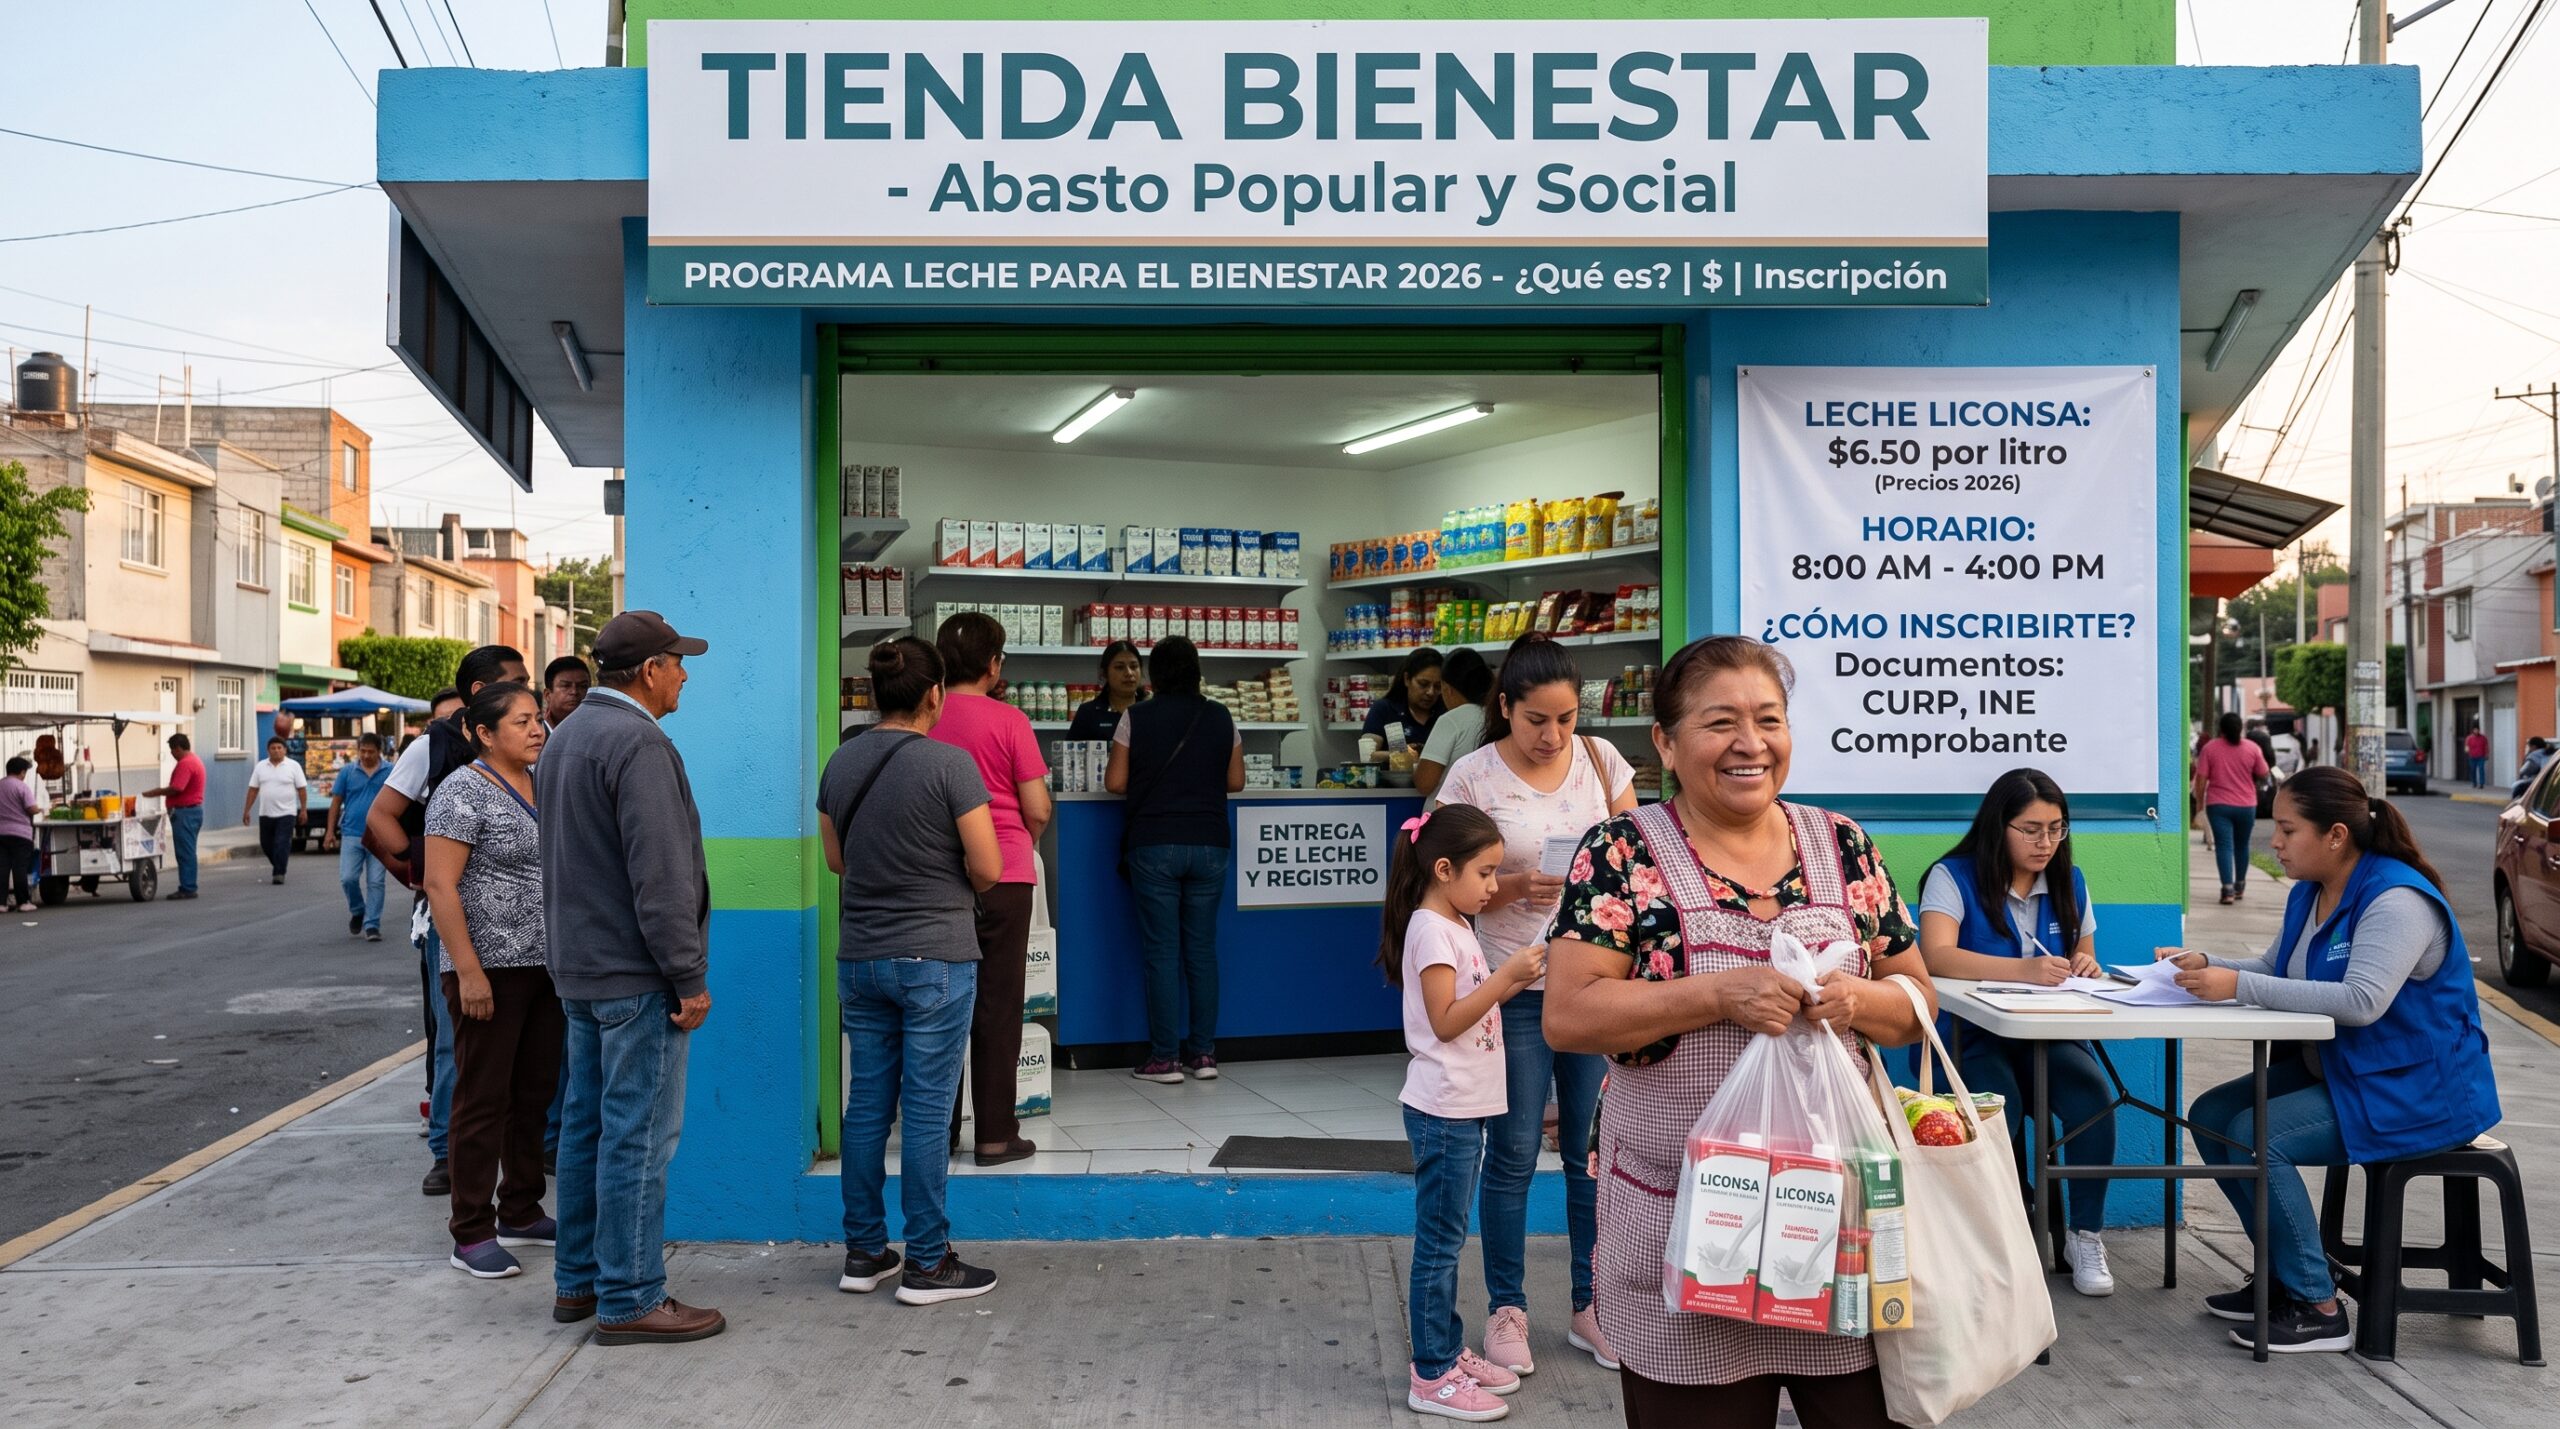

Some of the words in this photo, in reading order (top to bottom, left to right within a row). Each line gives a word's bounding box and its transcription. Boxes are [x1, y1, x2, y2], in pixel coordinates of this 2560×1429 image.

[702, 52, 1183, 140] TIENDA
[1225, 51, 1931, 142] BIENESTAR
[928, 160, 1169, 213] Abasto
[1194, 160, 1458, 226] Popular
[1476, 174, 1517, 227] y
[1536, 158, 1736, 214] Social
[684, 261, 894, 289] PROGRAMA
[904, 262, 1019, 289] LECHE
[1030, 262, 1128, 289] PARA
[1138, 262, 1180, 289] EL
[1190, 262, 1388, 289] BIENESTAR
[1397, 262, 1483, 289] 2026
[1515, 261, 1604, 295] ¿Qué
[1613, 262, 1672, 290] es?
[1702, 258, 1723, 294] $
[1755, 259, 1947, 296] Inscripción
[1805, 401, 1918, 427] LECHE
[1929, 401, 2091, 427] LICONSA:
[1828, 435, 1921, 469] $6.50
[1932, 445, 1989, 472] por
[1999, 437, 2067, 465] litro
[1875, 474, 1959, 495] (Precios
[1964, 474, 2021, 495] 2026)
[1862, 516, 2035, 542] HORARIO:
[1792, 554, 1867, 580] 8:00
[1876, 554, 1931, 580] AM
[1964, 554, 2041, 580] 4:00
[2052, 554, 2104, 580] PM
[1762, 607, 1888, 644] ¿CÓMO
[1900, 612, 2136, 639] INSCRIBIRTE?
[1835, 652, 2064, 678] Documentos:
[1862, 689, 1968, 720] CURP,
[1979, 689, 2036, 715] INE
[1831, 726, 2068, 760] Comprobante
[1260, 822, 1366, 842] ENTREGA
[1257, 847, 1288, 865] DE
[1295, 845, 1368, 864] LECHE
[1245, 870, 1261, 888] Y
[1267, 867, 1379, 888] REGISTRO
[1700, 1172, 1760, 1193] LICONSA
[1775, 1186, 1836, 1206] LICONSA
